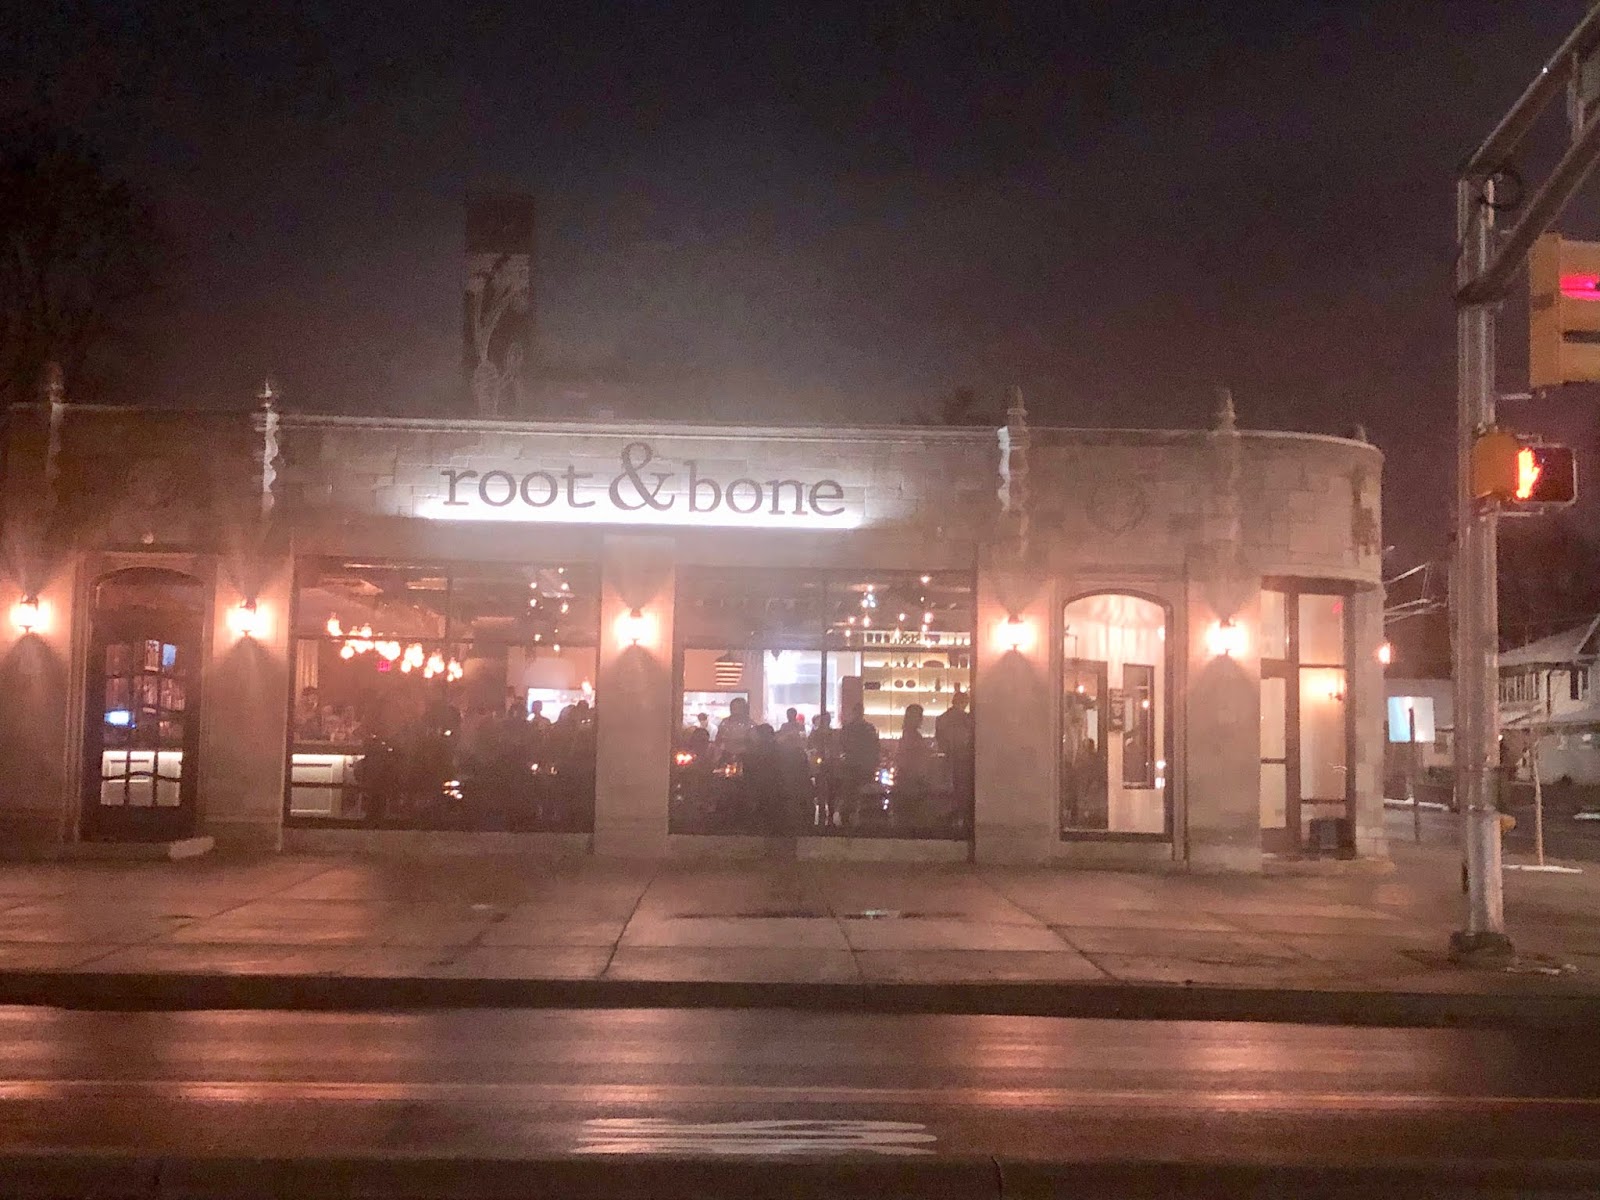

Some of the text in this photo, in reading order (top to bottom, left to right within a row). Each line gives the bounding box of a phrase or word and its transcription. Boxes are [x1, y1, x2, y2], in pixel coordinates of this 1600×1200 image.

[440, 441, 846, 517] root & bone
